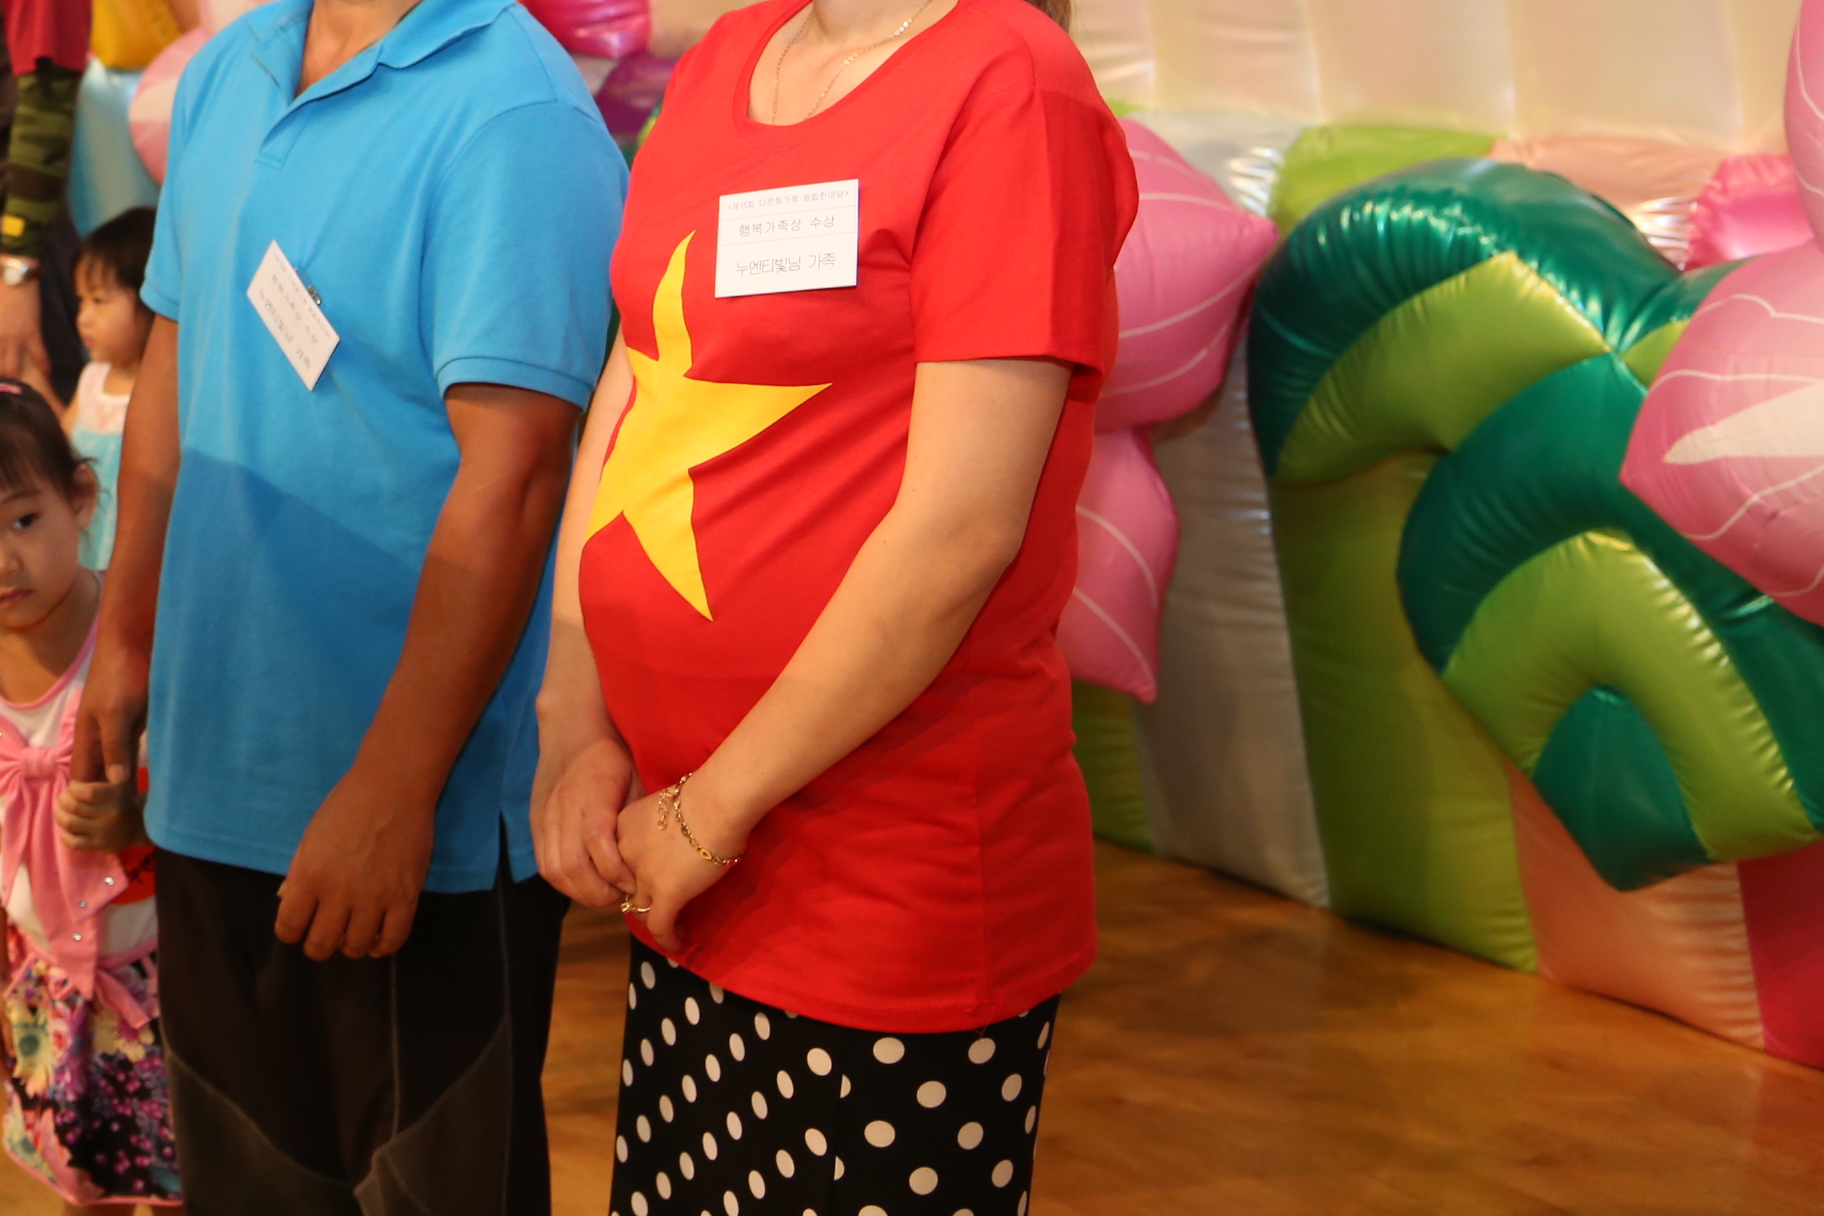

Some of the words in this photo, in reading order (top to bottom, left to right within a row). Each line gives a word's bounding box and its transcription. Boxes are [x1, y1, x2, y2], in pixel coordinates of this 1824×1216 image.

[759, 195, 798, 207] 다문화가족
[739, 218, 801, 237] 행복가족상
[810, 214, 835, 229] 수상
[808, 252, 836, 269] 가족
